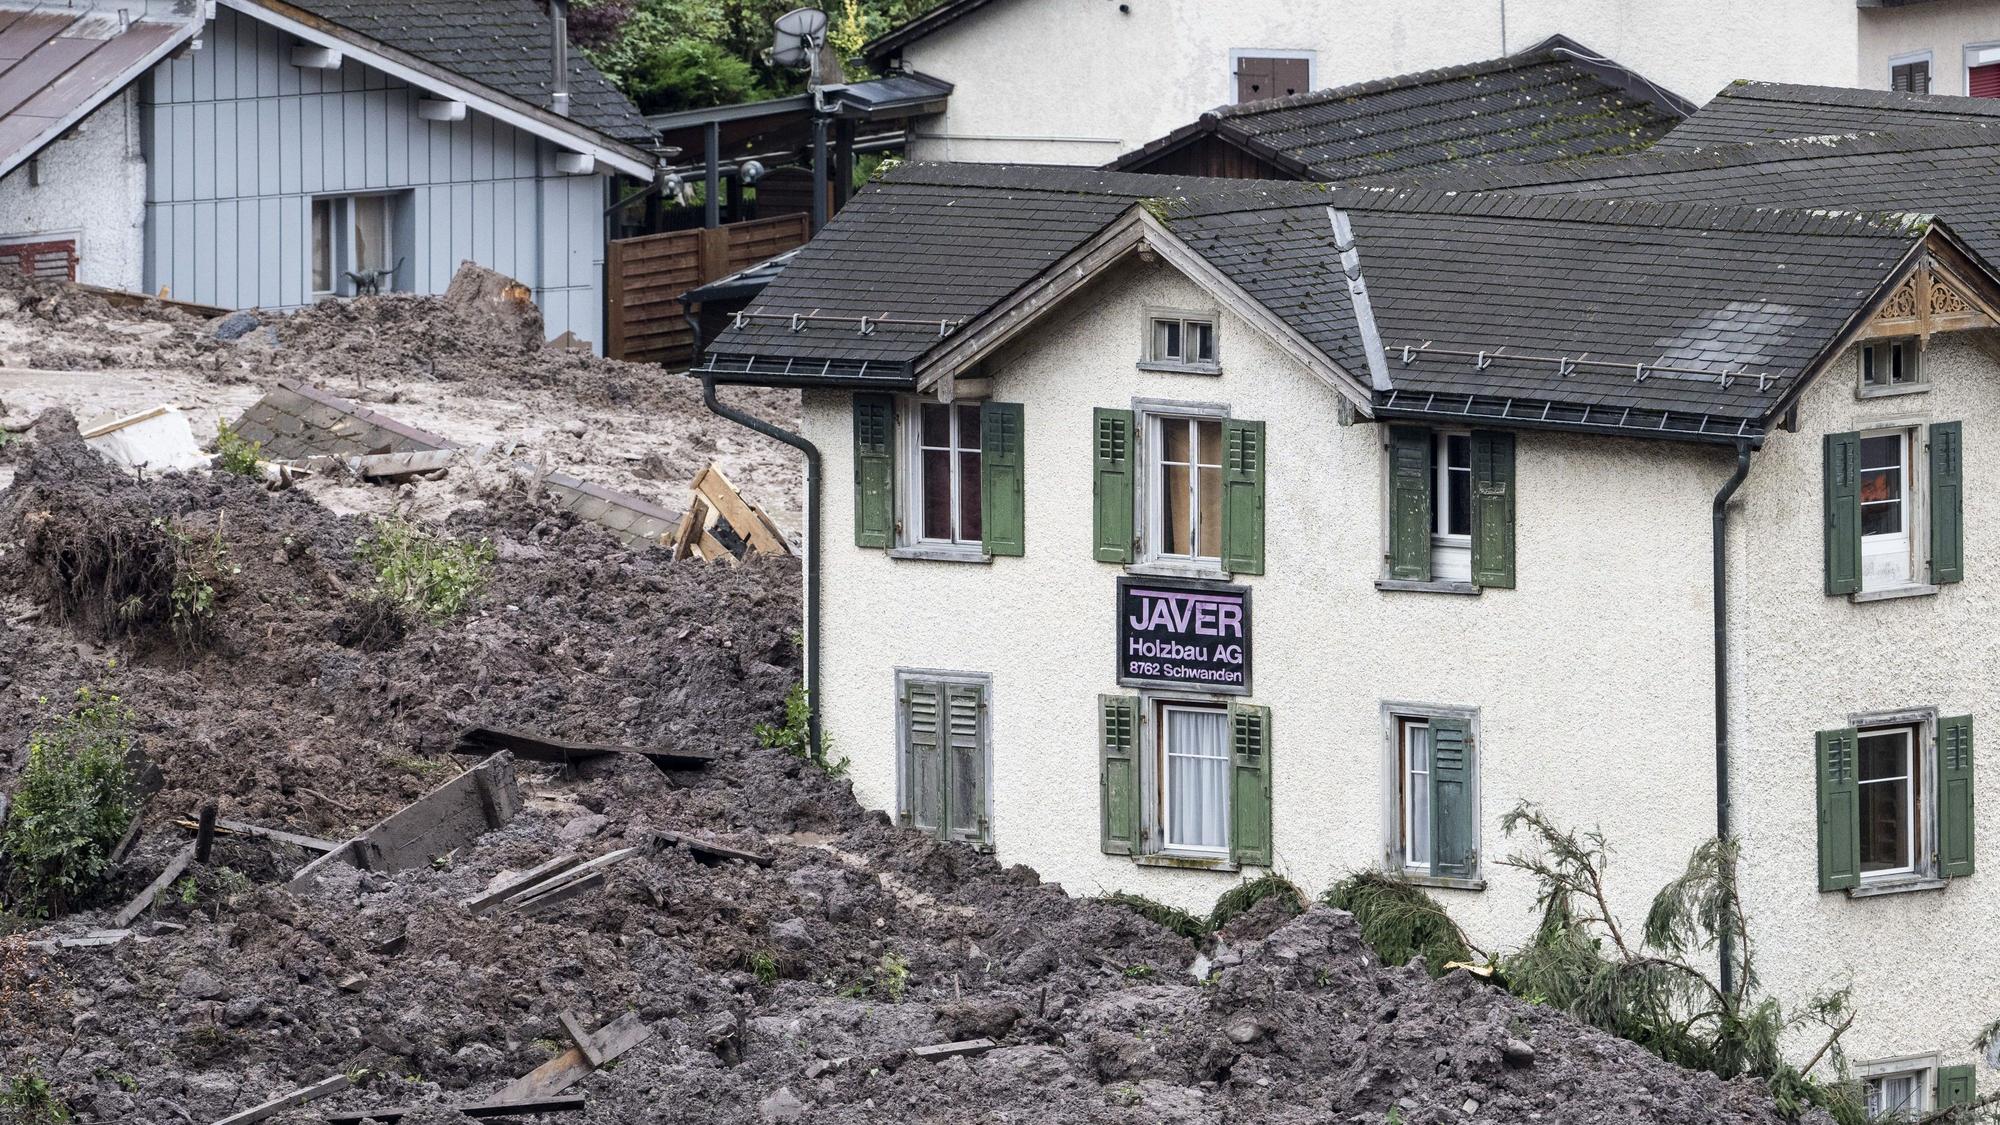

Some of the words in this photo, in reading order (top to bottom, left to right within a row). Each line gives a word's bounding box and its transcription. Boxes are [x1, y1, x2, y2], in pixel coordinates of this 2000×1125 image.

[1130, 597, 1242, 638] JAVER
[1130, 637, 1207, 661] Holzbau
[1213, 644, 1242, 664] AG
[1130, 661, 1160, 675] 8762
[1164, 664, 1242, 682] Schwanden
